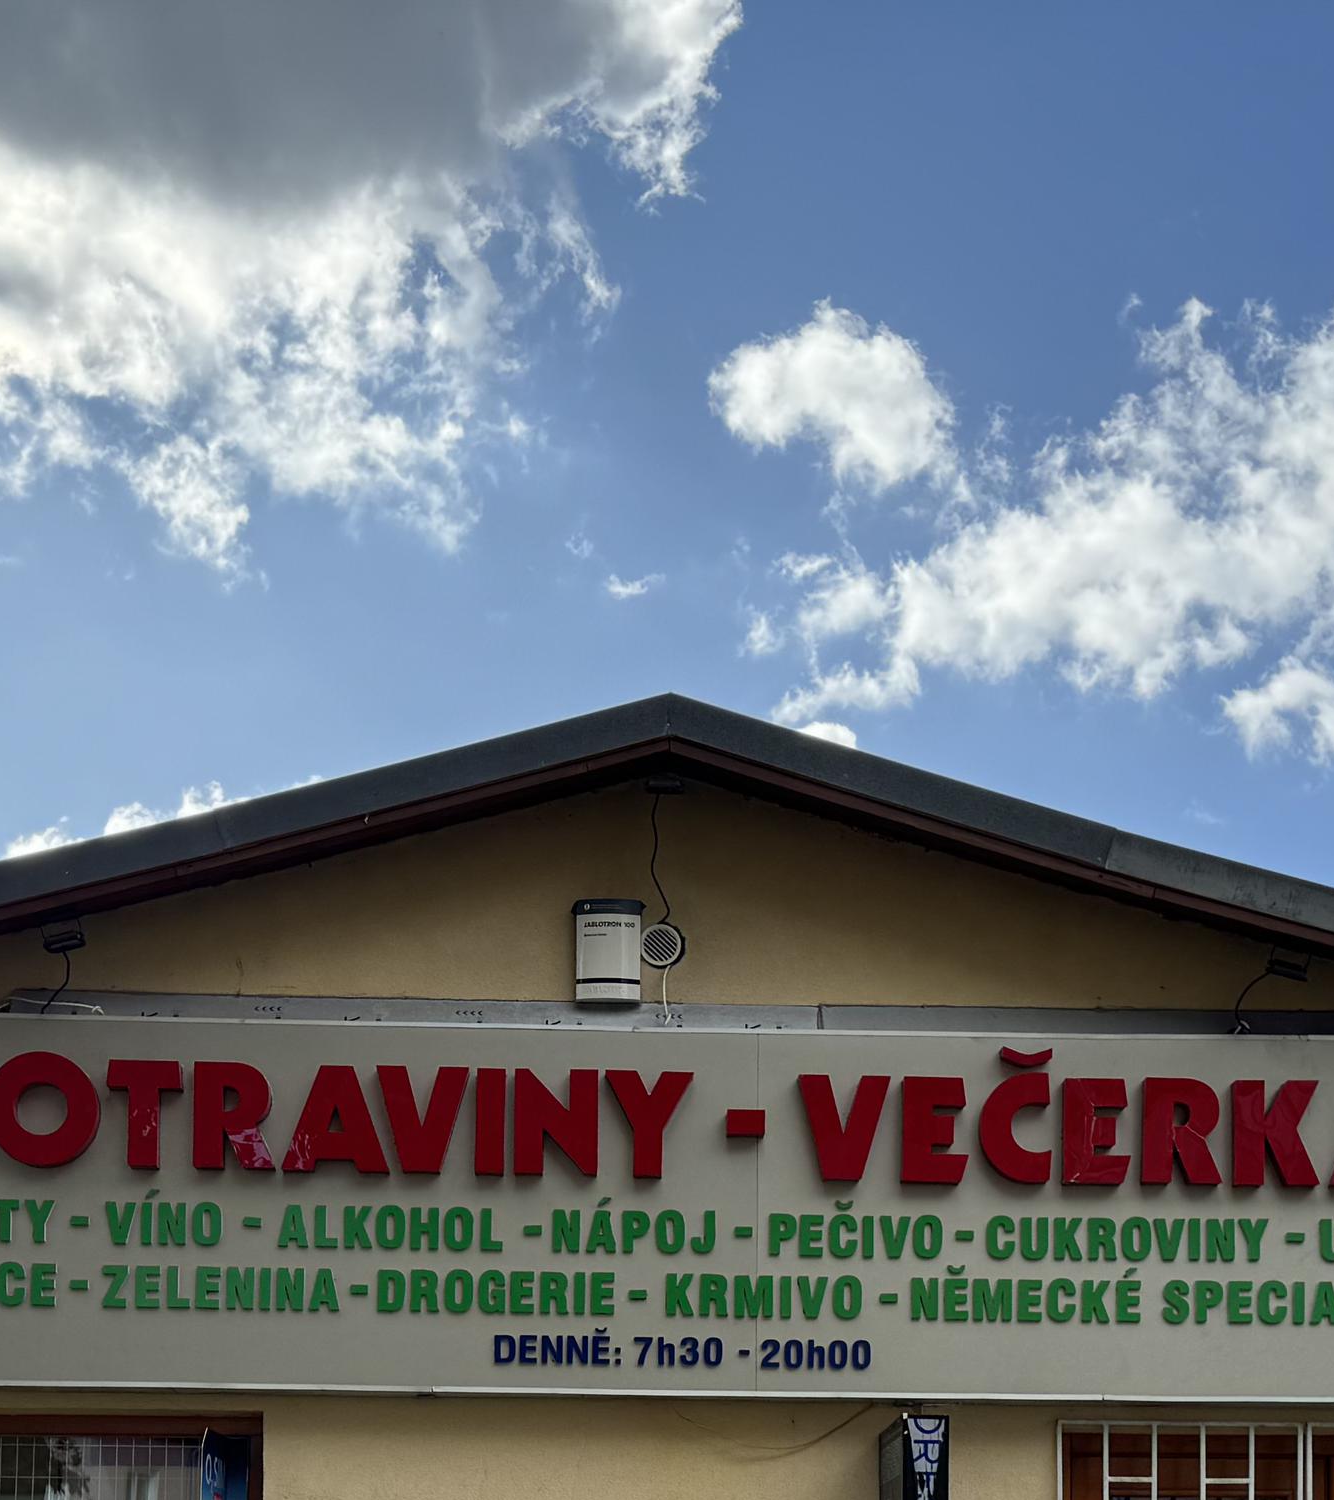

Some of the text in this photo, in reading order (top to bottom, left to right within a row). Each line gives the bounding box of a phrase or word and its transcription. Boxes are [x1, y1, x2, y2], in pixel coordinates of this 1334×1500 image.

[105, 1189, 224, 1248] VÍNO
[277, 1204, 505, 1254] ALKOHOL
[551, 1198, 717, 1256] NÁPOJ
[767, 1201, 945, 1261] PEČIVO
[985, 1215, 1269, 1264] CUKROVINY
[101, 1264, 341, 1314] ZELENINA
[375, 1267, 617, 1318] DROGERIE
[665, 1273, 865, 1321] KRMIVO
[909, 1264, 1143, 1325] NĚMECKÉ
[493, 1326, 623, 1367] DENNĚ:
[633, 1336, 724, 1369] 7h30
[760, 1339, 873, 1371] 20h00
